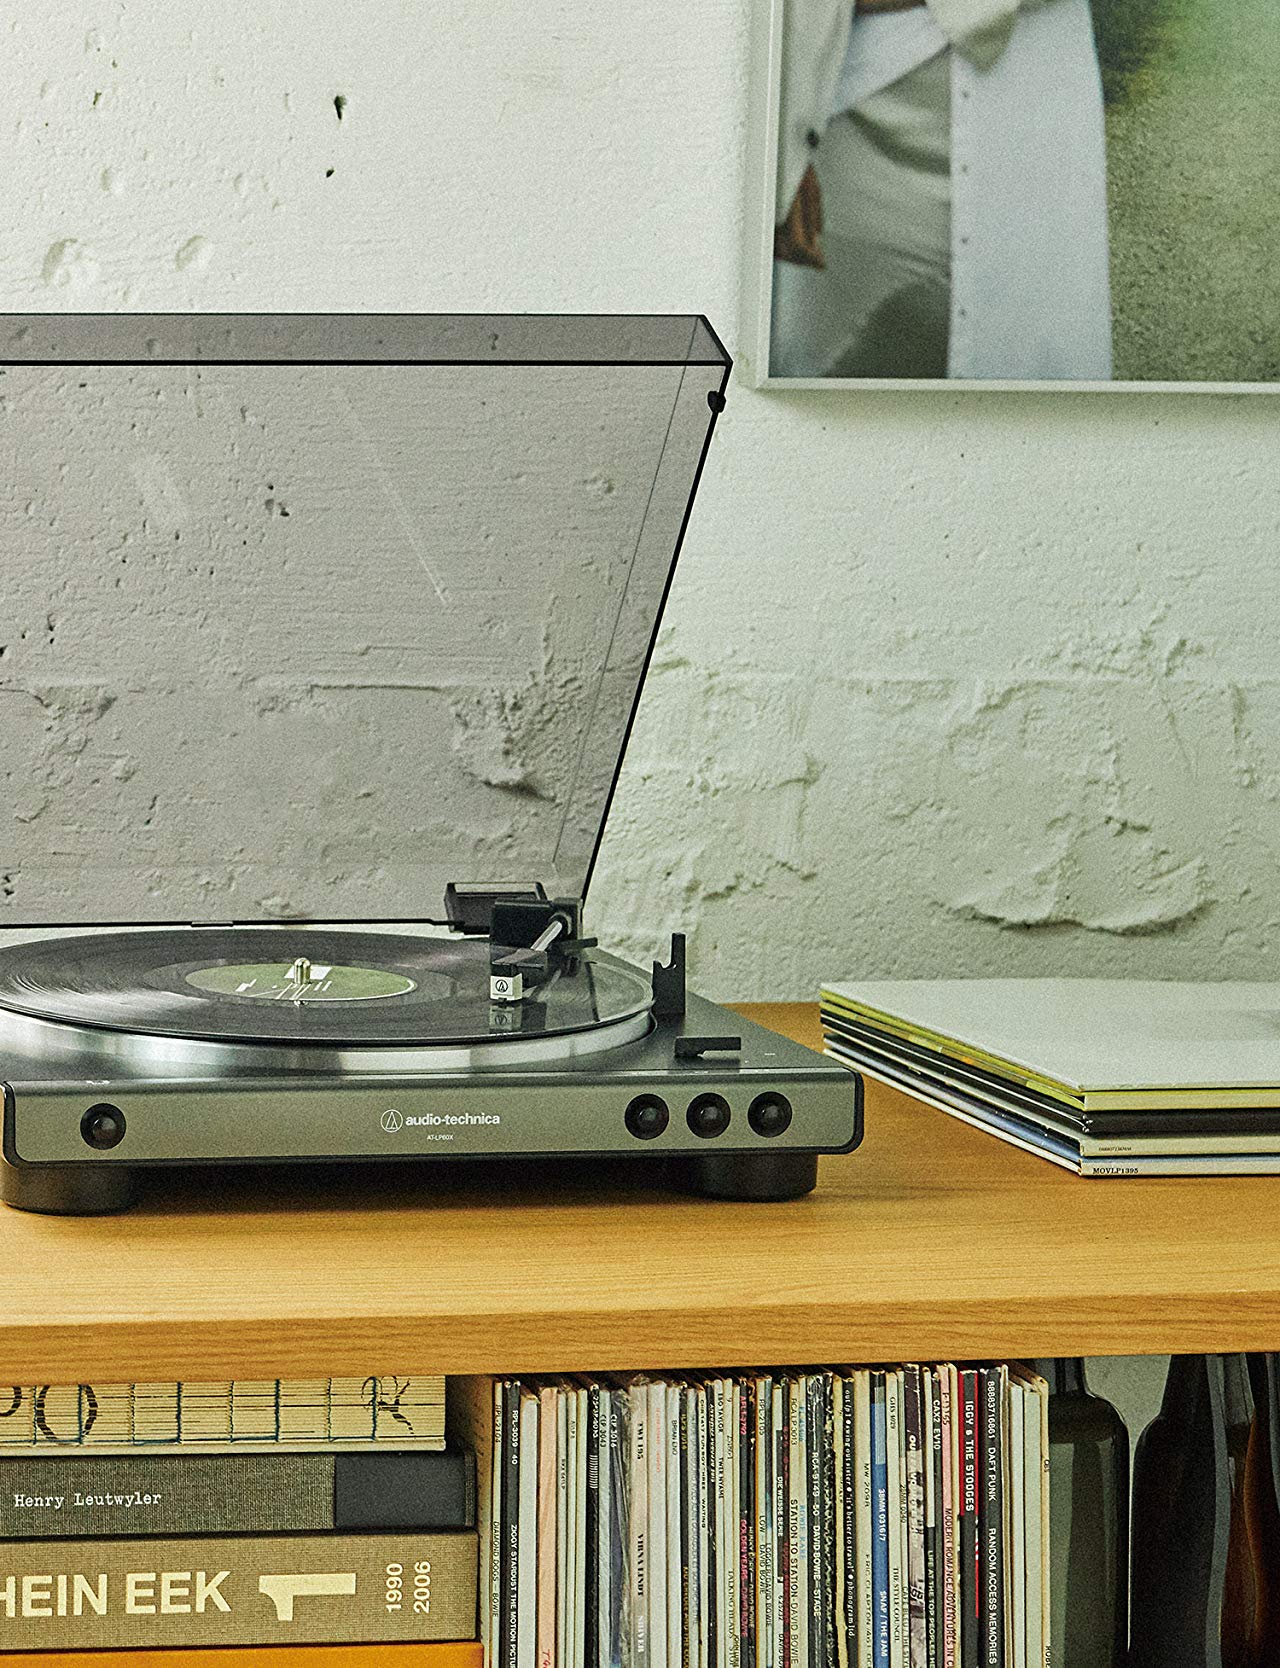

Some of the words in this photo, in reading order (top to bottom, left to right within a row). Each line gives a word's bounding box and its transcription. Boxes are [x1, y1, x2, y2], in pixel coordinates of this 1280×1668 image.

[405, 1112, 500, 1126] audio-technica
[1093, 1167, 1139, 1175] MOVLP1395
[988, 1447, 996, 1472] DAFT
[966, 1465, 974, 1511] STOOGES
[988, 1474, 996, 1501] PUNK
[14, 1494, 64, 1510] Henry
[73, 1492, 162, 1508] Leutwyler
[791, 1542, 798, 1555] TO
[847, 1537, 853, 1545] to
[928, 1569, 934, 1578] AT
[125, 1570, 232, 1615] EEK
[385, 1563, 403, 1613] 1990
[413, 1560, 431, 1613] 2006
[989, 1613, 997, 1664] MEMORIES
[947, 1648, 953, 1657] IN
